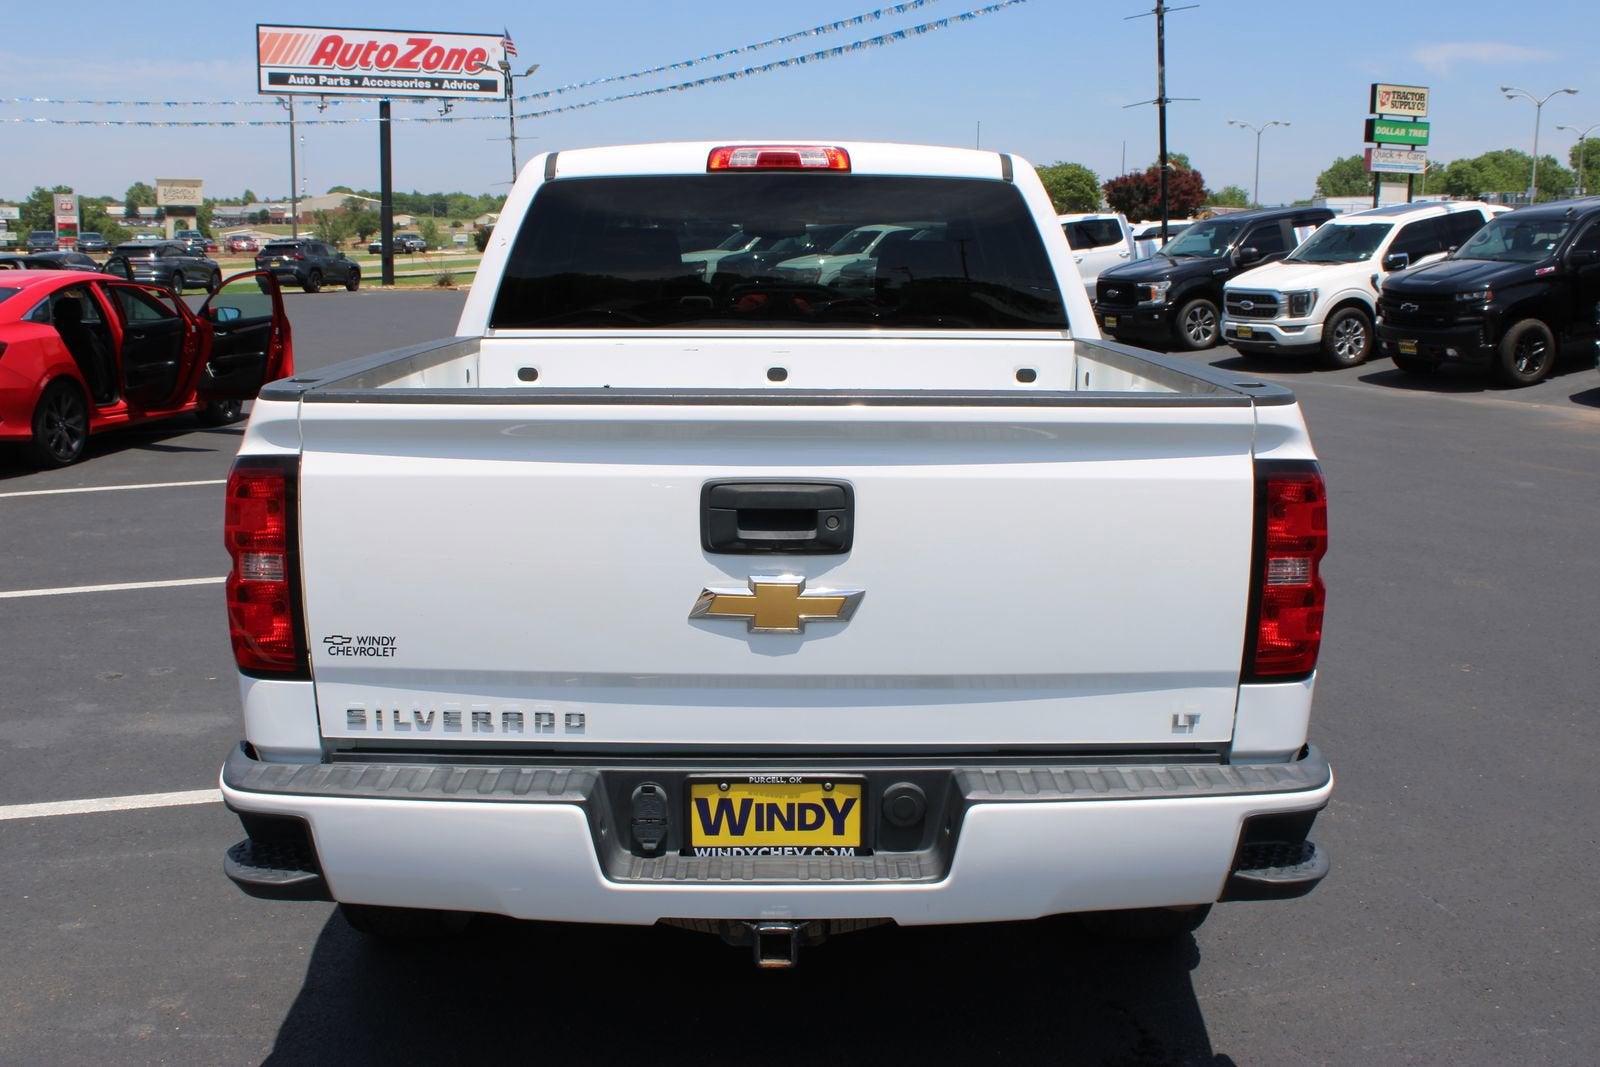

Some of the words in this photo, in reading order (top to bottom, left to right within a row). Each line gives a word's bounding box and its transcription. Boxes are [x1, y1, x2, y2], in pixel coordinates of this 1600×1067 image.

[309, 34, 489, 73] AutoZone
[287, 74, 316, 86] Auto
[319, 75, 351, 87] Parts
[361, 78, 431, 89] Accessories
[442, 80, 480, 91] Advice
[1391, 91, 1425, 101] TRACTOR
[1390, 101, 1416, 110] SUPPLY
[1375, 126, 1406, 136] DOLLAR
[1409, 128, 1428, 138] TREE
[1407, 151, 1425, 161] Care
[356, 636, 397, 647] WINDY
[327, 646, 397, 657] CHEVROLET
[346, 706, 586, 732] SILVERADO
[1171, 712, 1201, 734] LT
[789, 776, 802, 784] OK
[694, 798, 858, 836] WINDY
[693, 847, 855, 857] WINDYCHEVCOM
